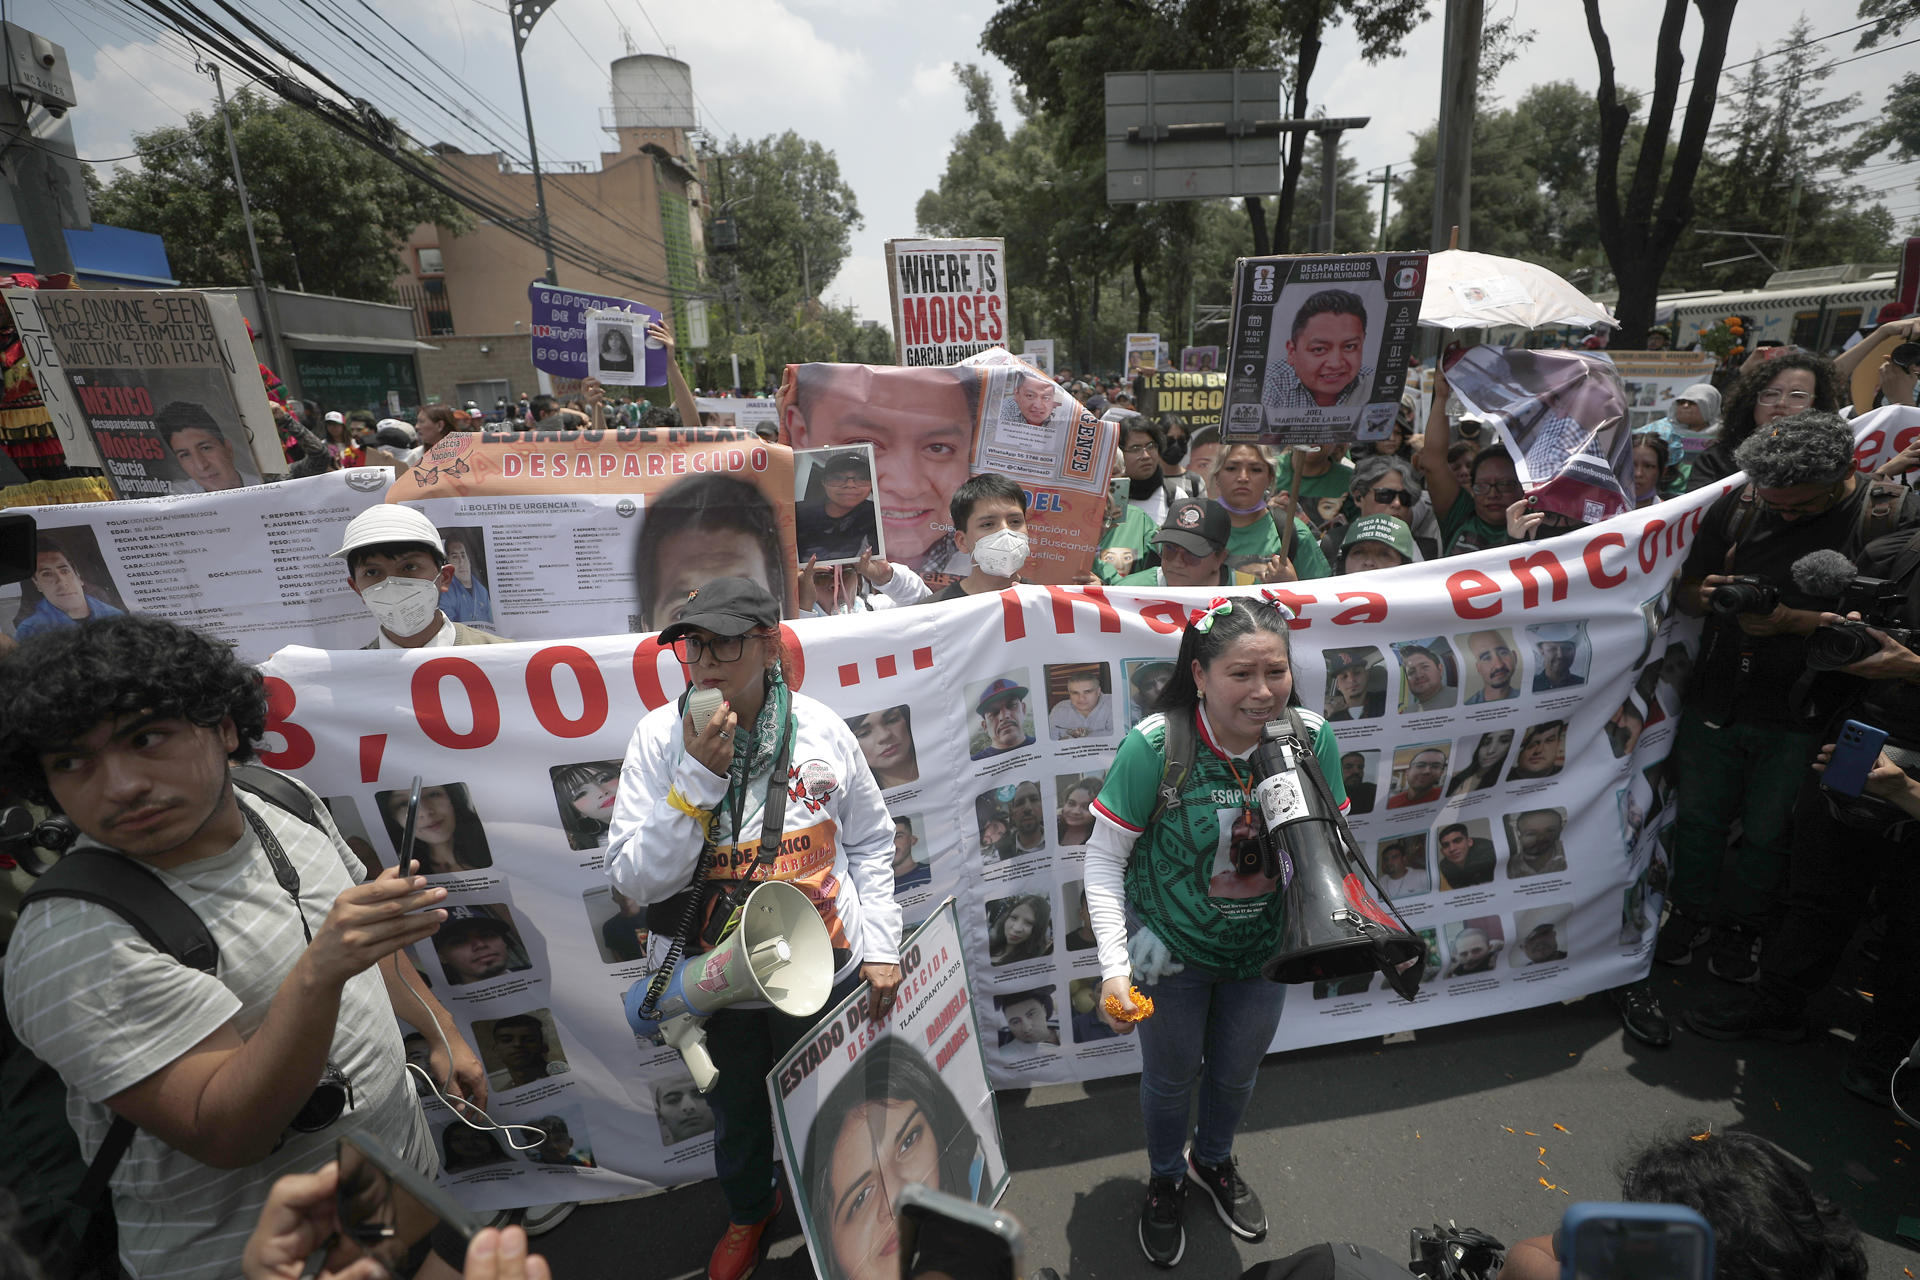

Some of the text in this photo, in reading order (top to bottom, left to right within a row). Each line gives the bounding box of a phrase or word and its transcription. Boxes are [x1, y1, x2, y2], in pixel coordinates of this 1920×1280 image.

[898, 254, 997, 294] WHERE IS
[1301, 262, 1371, 272] DESAPARECIDOS
[1334, 271, 1370, 279] OLVIDADOS
[540, 292, 608, 310] CAPITAL
[36, 295, 209, 324] HAS ANYONE SEEN
[552, 309, 568, 322] DE
[904, 288, 1002, 346] MOISÉS
[114, 324, 140, 341] HIS
[140, 324, 196, 341] FAMILY
[200, 324, 214, 342] IS
[53, 341, 220, 366] WAITING FOR HIM.
[536, 348, 588, 362] SOCIA
[907, 344, 944, 366] GARCÍA
[74, 375, 86, 384] en
[1144, 373, 1204, 388] TE SIGO
[78, 380, 154, 416] MÉXICO
[1158, 390, 1224, 412] DIEGO
[90, 418, 156, 430] desaparecieron a
[1275, 416, 1310, 424] MARTÍNEZ
[95, 431, 166, 460] Moisés
[988, 448, 1016, 457] WhatsApp
[108, 459, 147, 476] García
[503, 447, 768, 478] DESAPARECIDO
[114, 475, 174, 493] Hernández
[350, 472, 380, 481] FGJ
[269, 511, 306, 519] REPORTE:
[469, 503, 507, 512] BOLETÍN
[150, 531, 198, 540] NACIMIENTO:
[1027, 522, 1080, 536] mación al
[118, 544, 156, 552] ESTATURA:
[1039, 538, 1096, 553] Buscando
[1030, 552, 1065, 562] usticia
[126, 570, 162, 578] CABELLO:
[899, 960, 961, 1031] TLALNEPANTLA 2015
[925, 986, 968, 1046] DANIELA
[778, 1020, 845, 1100] ESTADO
[846, 995, 868, 1034] DE
[935, 1023, 970, 1074] MABEL
